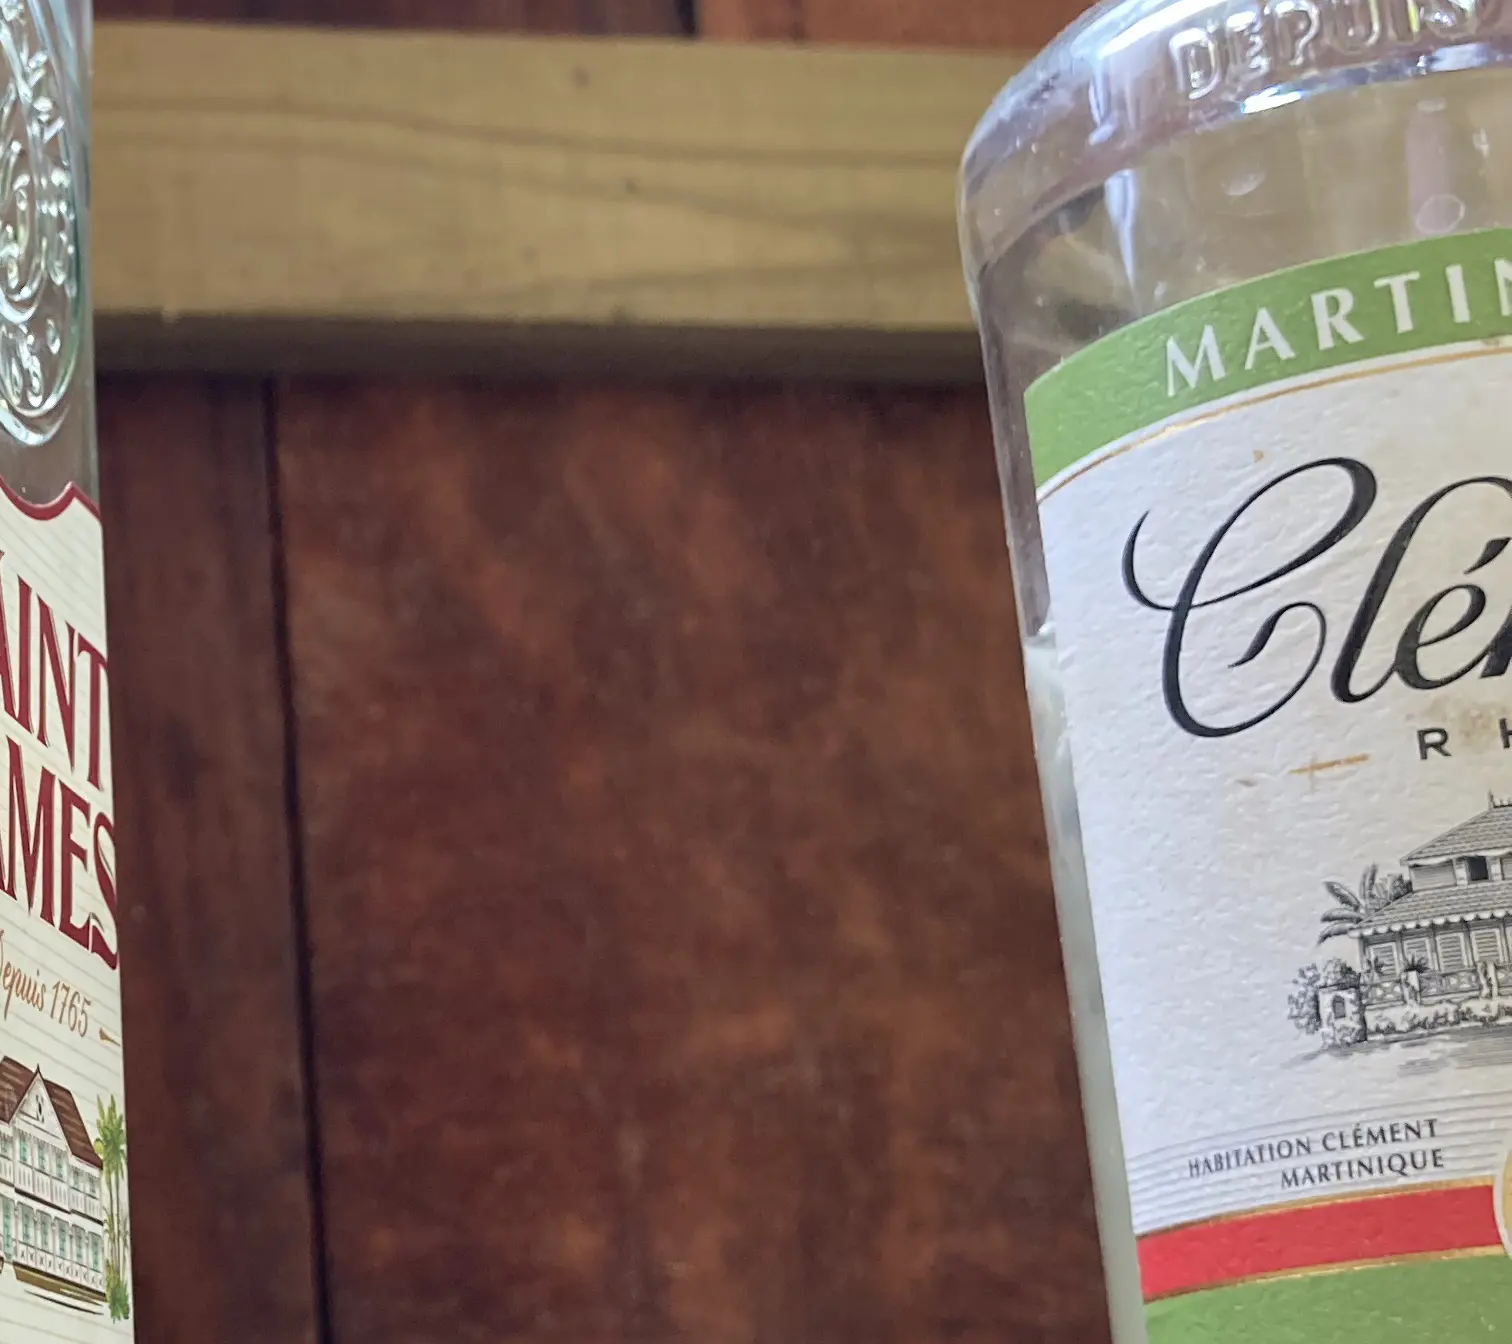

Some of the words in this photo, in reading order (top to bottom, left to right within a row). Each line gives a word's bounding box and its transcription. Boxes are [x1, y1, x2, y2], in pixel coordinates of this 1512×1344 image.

[1121, 456, 1512, 738] Clé
[51, 980, 92, 1039] 1765
[1188, 1136, 1311, 1178] HABITATION
[1322, 1118, 1438, 1153] CLÉMENT
[1280, 1148, 1445, 1189] MARTINIQUE
